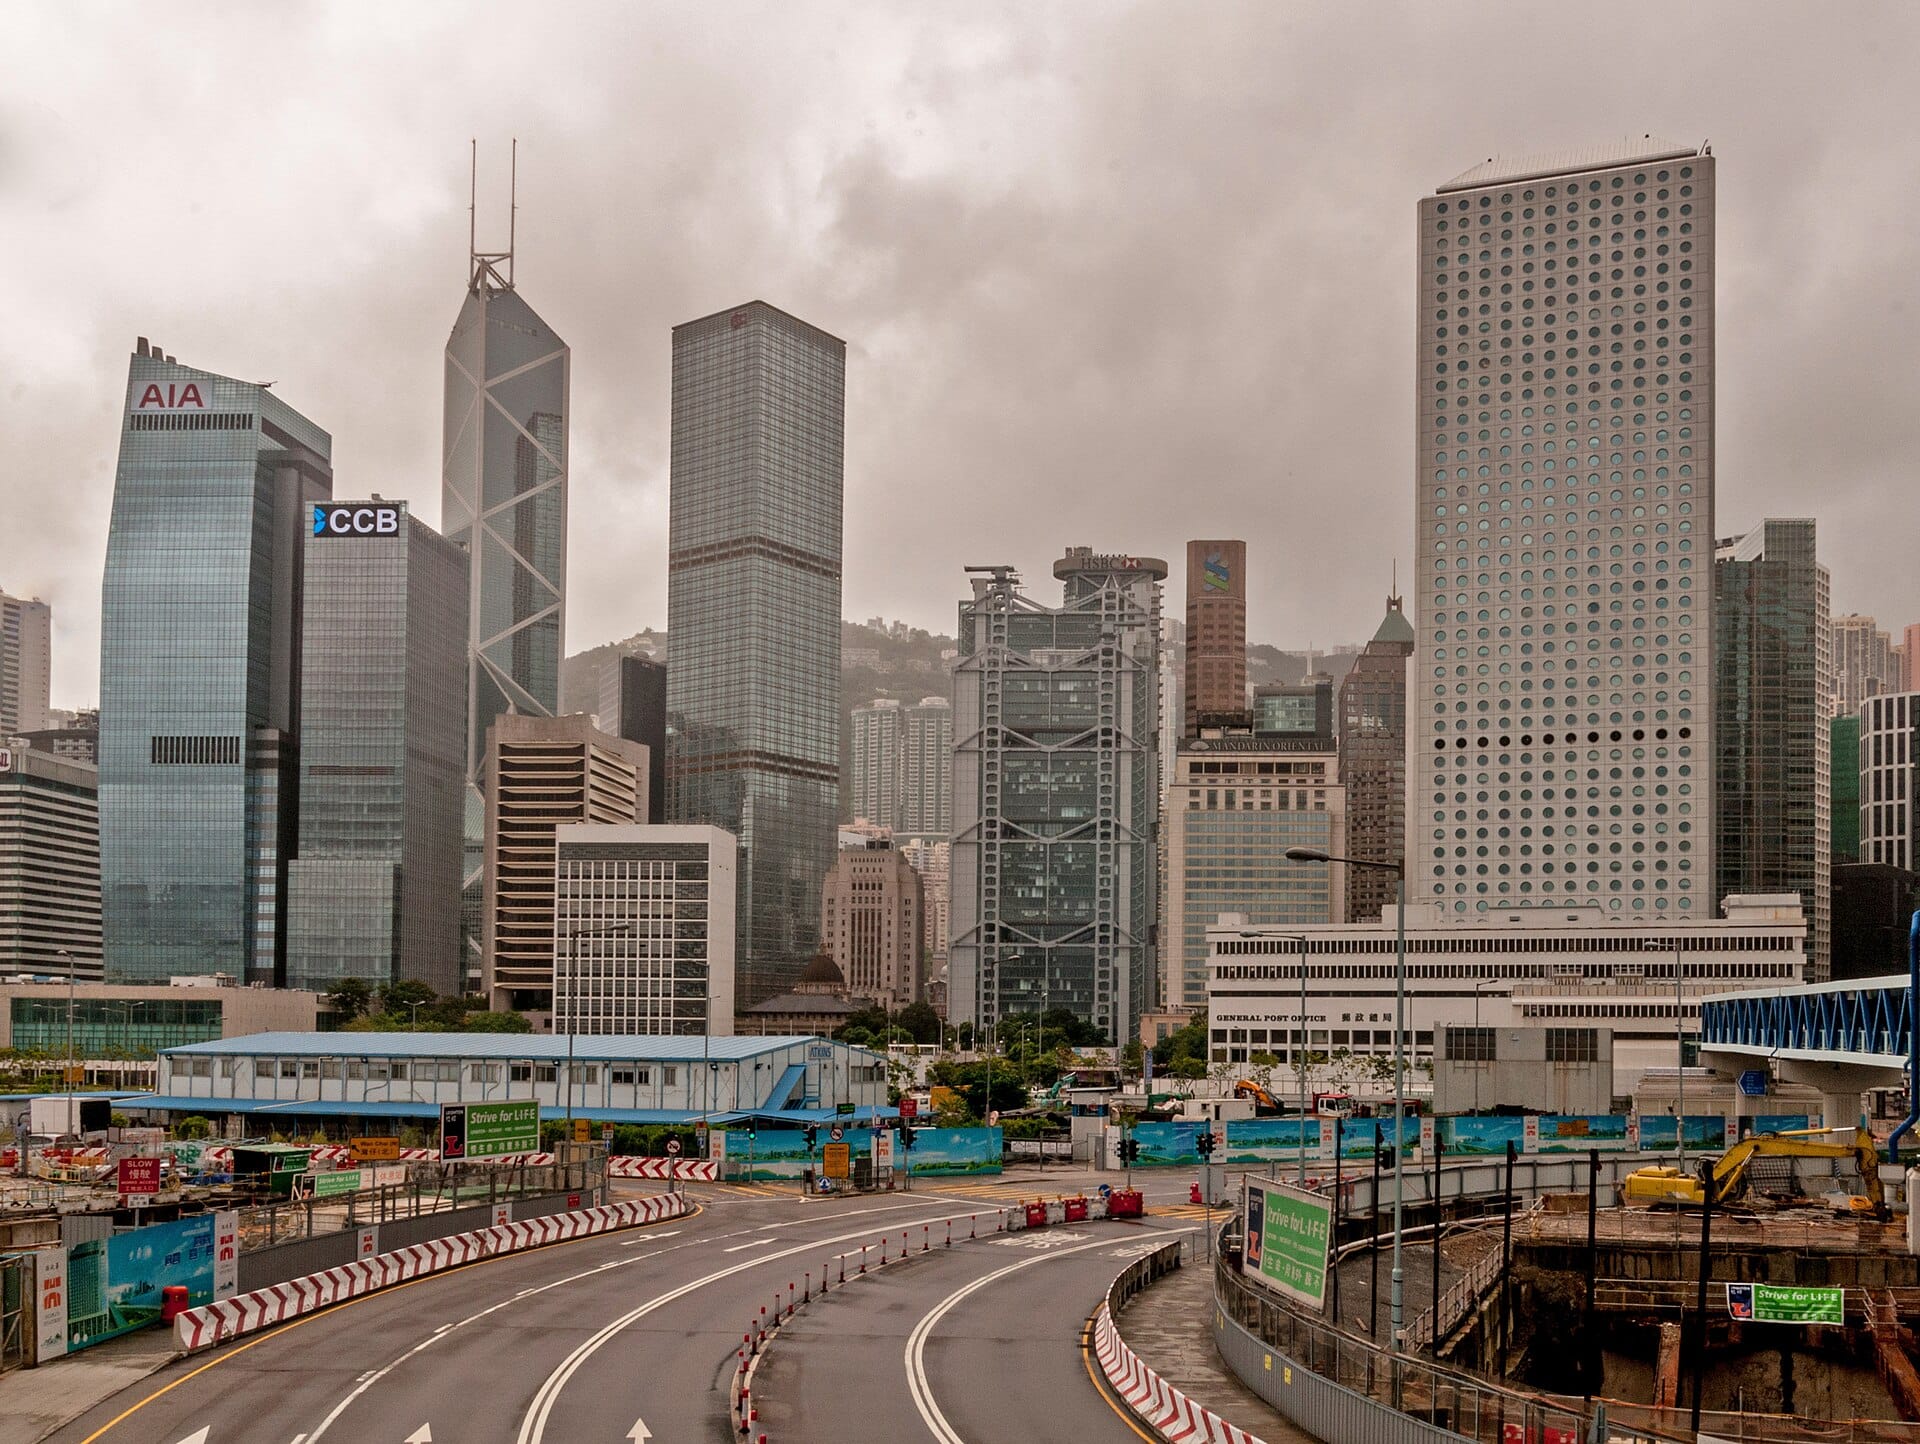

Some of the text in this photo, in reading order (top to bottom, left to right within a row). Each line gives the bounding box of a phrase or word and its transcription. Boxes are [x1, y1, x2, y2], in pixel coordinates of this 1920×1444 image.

[139, 384, 204, 408] AIA
[330, 509, 398, 533] CCB
[1082, 558, 1120, 569] HSBC
[1212, 741, 1324, 750] MANDARIN ORIENTAL
[1216, 1014, 1262, 1022] GENERAL
[1264, 1014, 1289, 1022] POST
[1341, 1012, 1392, 1023] 郵政總局
[810, 1046, 831, 1057] ATKINS
[470, 1111, 497, 1124] Strive
[500, 1109, 513, 1121] for
[127, 1160, 153, 1168] SLOW
[1759, 1290, 1789, 1300] Strive
[1791, 1290, 1808, 1300] for
